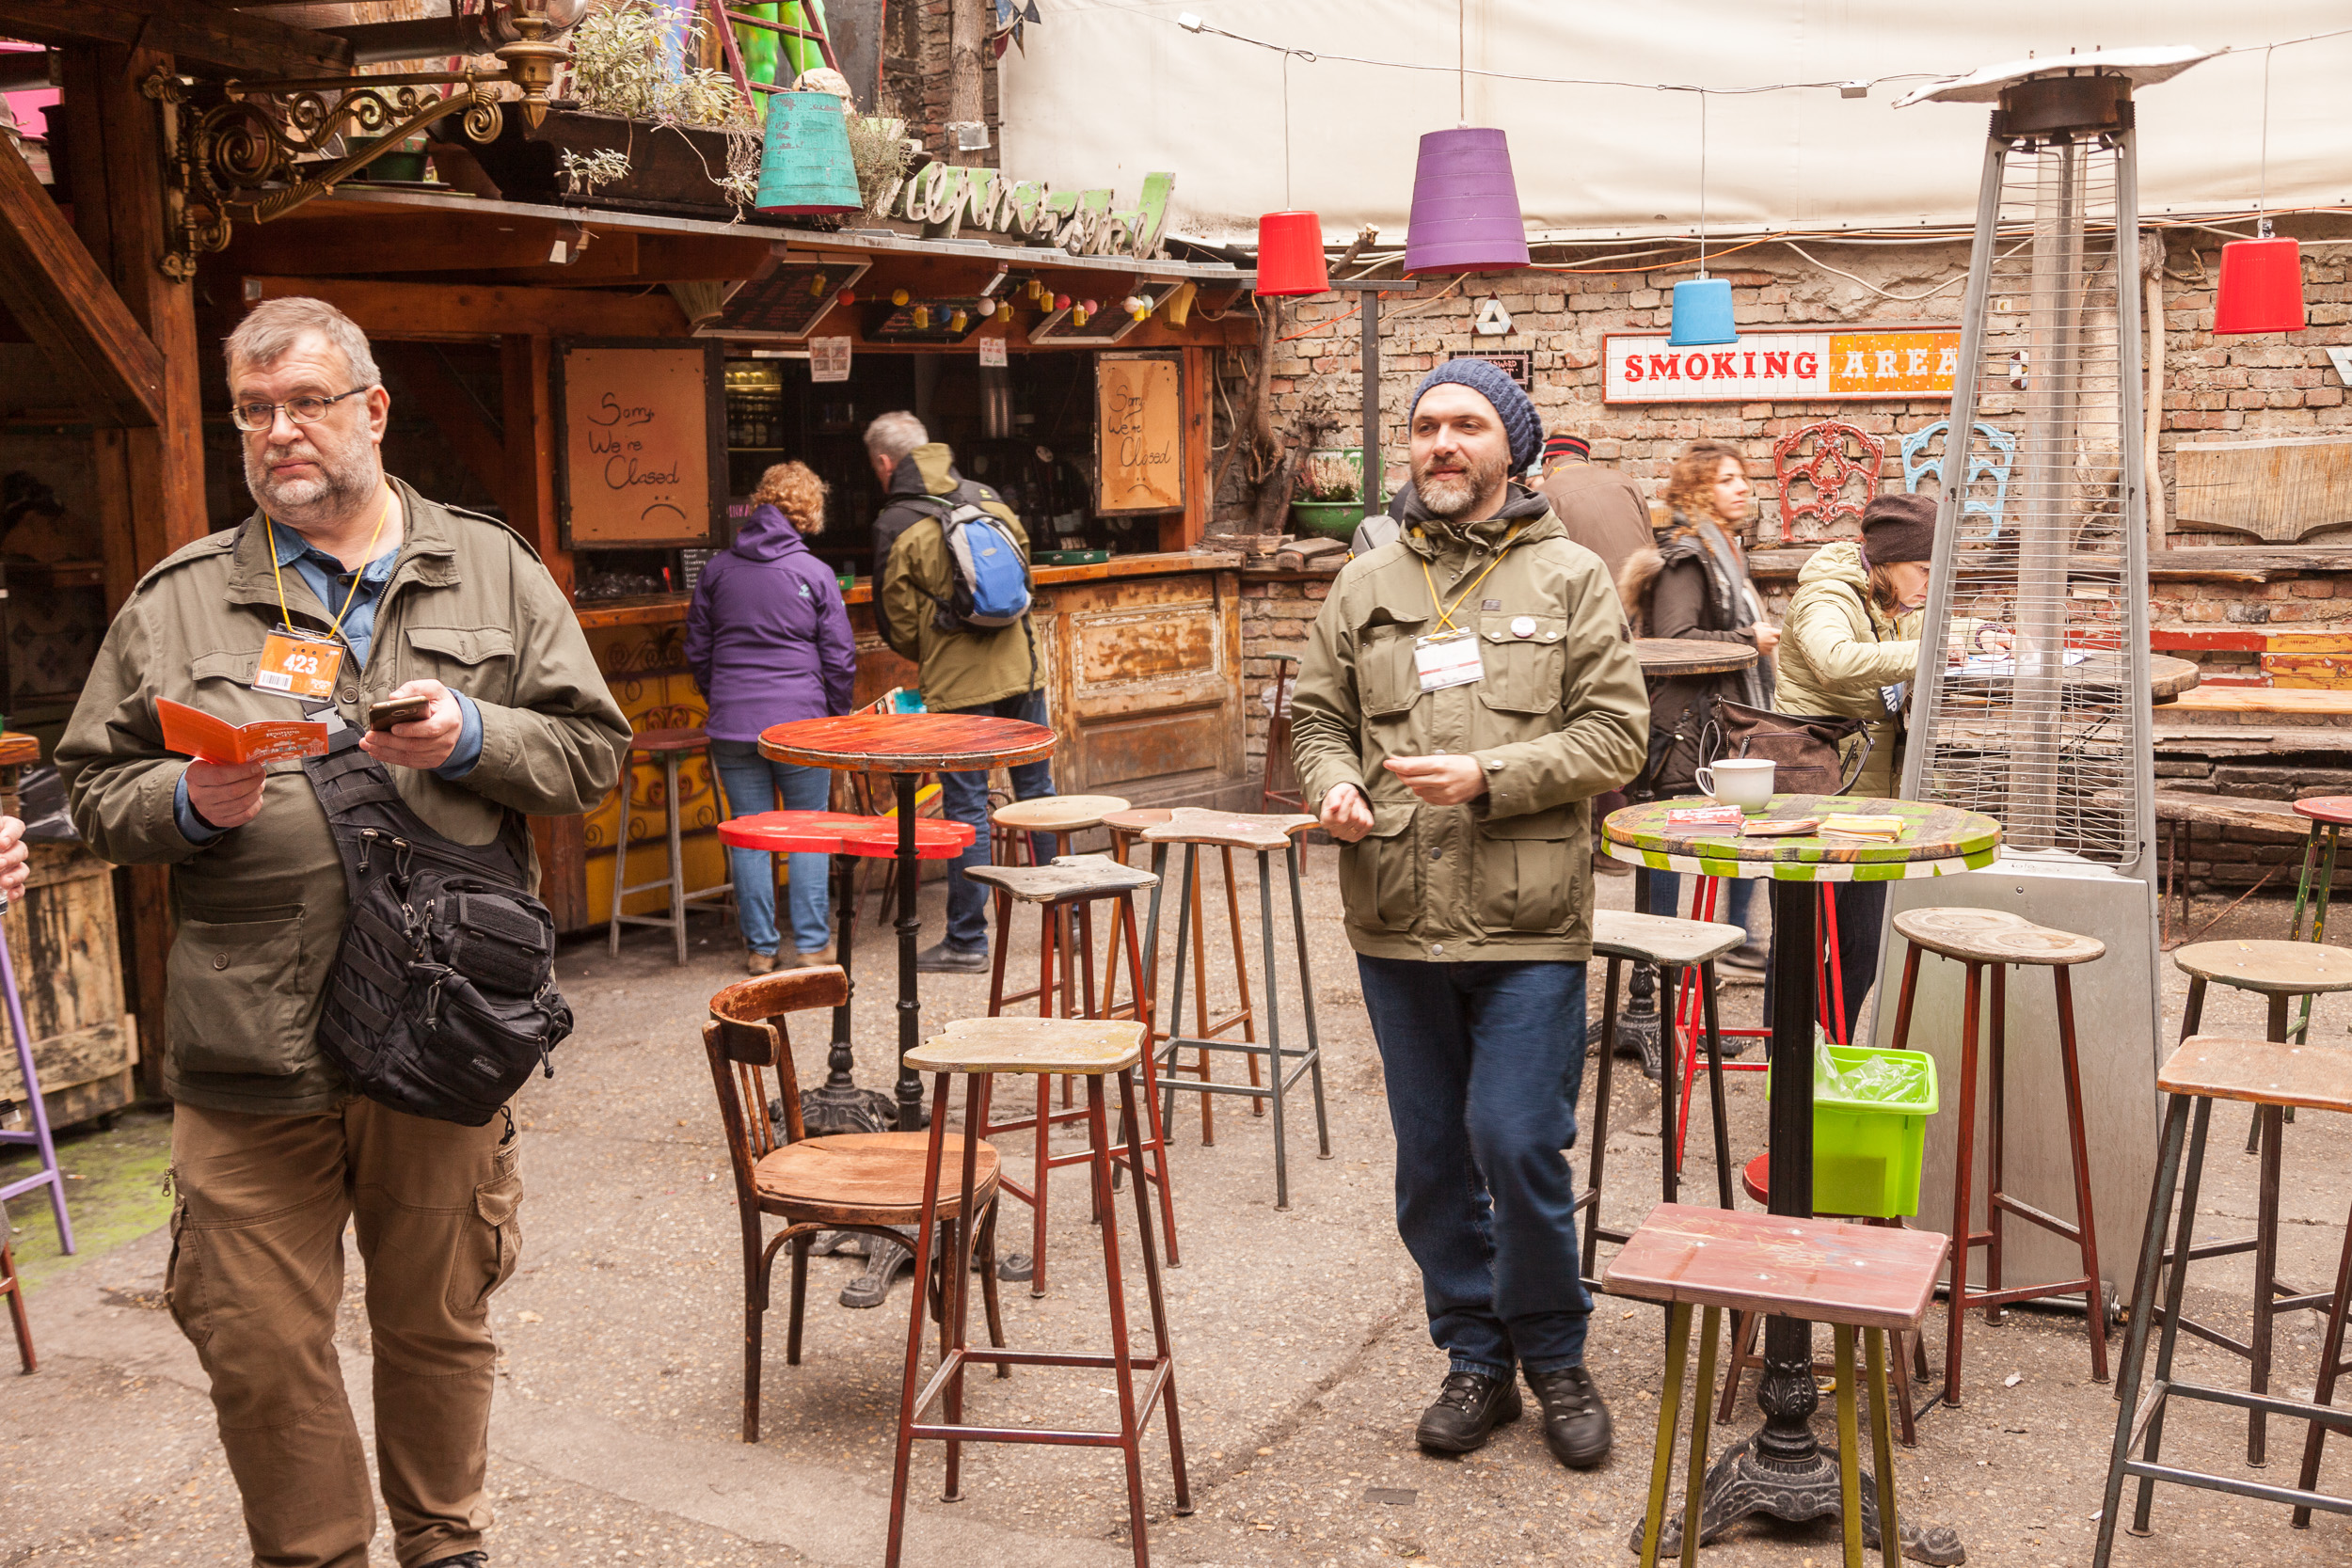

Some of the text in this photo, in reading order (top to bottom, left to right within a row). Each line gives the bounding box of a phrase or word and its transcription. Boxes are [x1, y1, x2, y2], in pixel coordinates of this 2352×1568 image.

[1625, 348, 1959, 383] SMOKING AREA
[1120, 436, 1171, 467] Closed
[283, 653, 319, 675] 423
